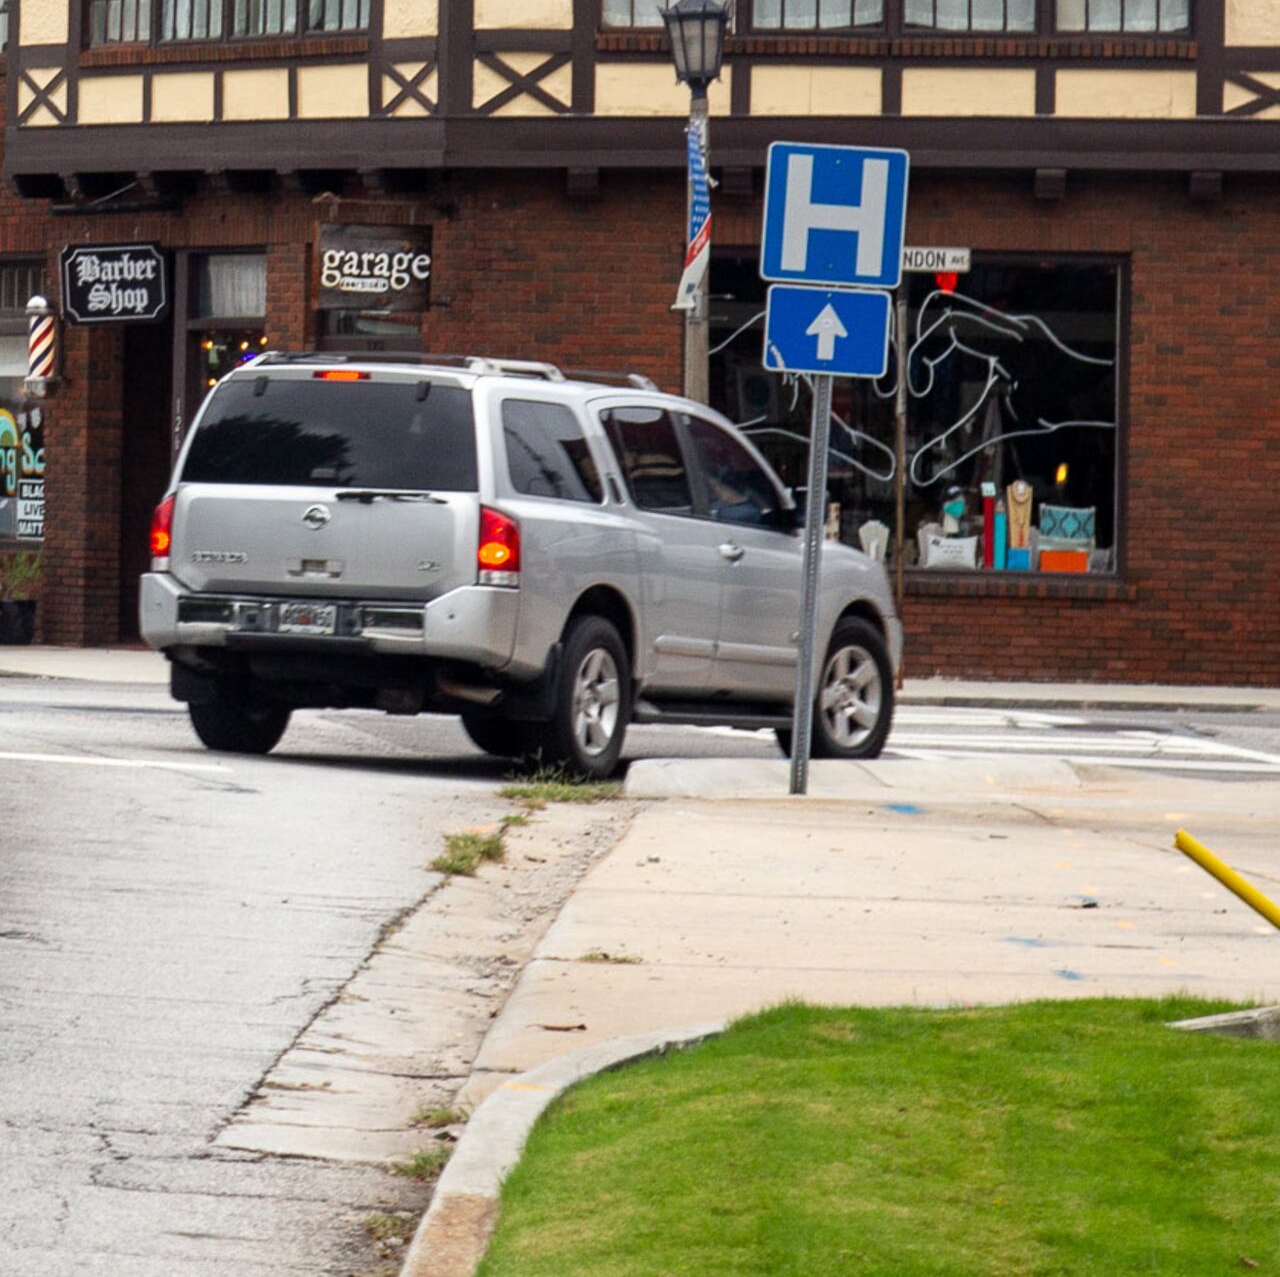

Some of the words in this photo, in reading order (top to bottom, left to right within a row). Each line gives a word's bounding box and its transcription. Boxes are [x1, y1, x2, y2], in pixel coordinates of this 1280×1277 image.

[780, 153, 890, 276] H
[76, 253, 157, 287] Barber
[321, 249, 431, 290] garage
[87, 283, 149, 314] Shop
